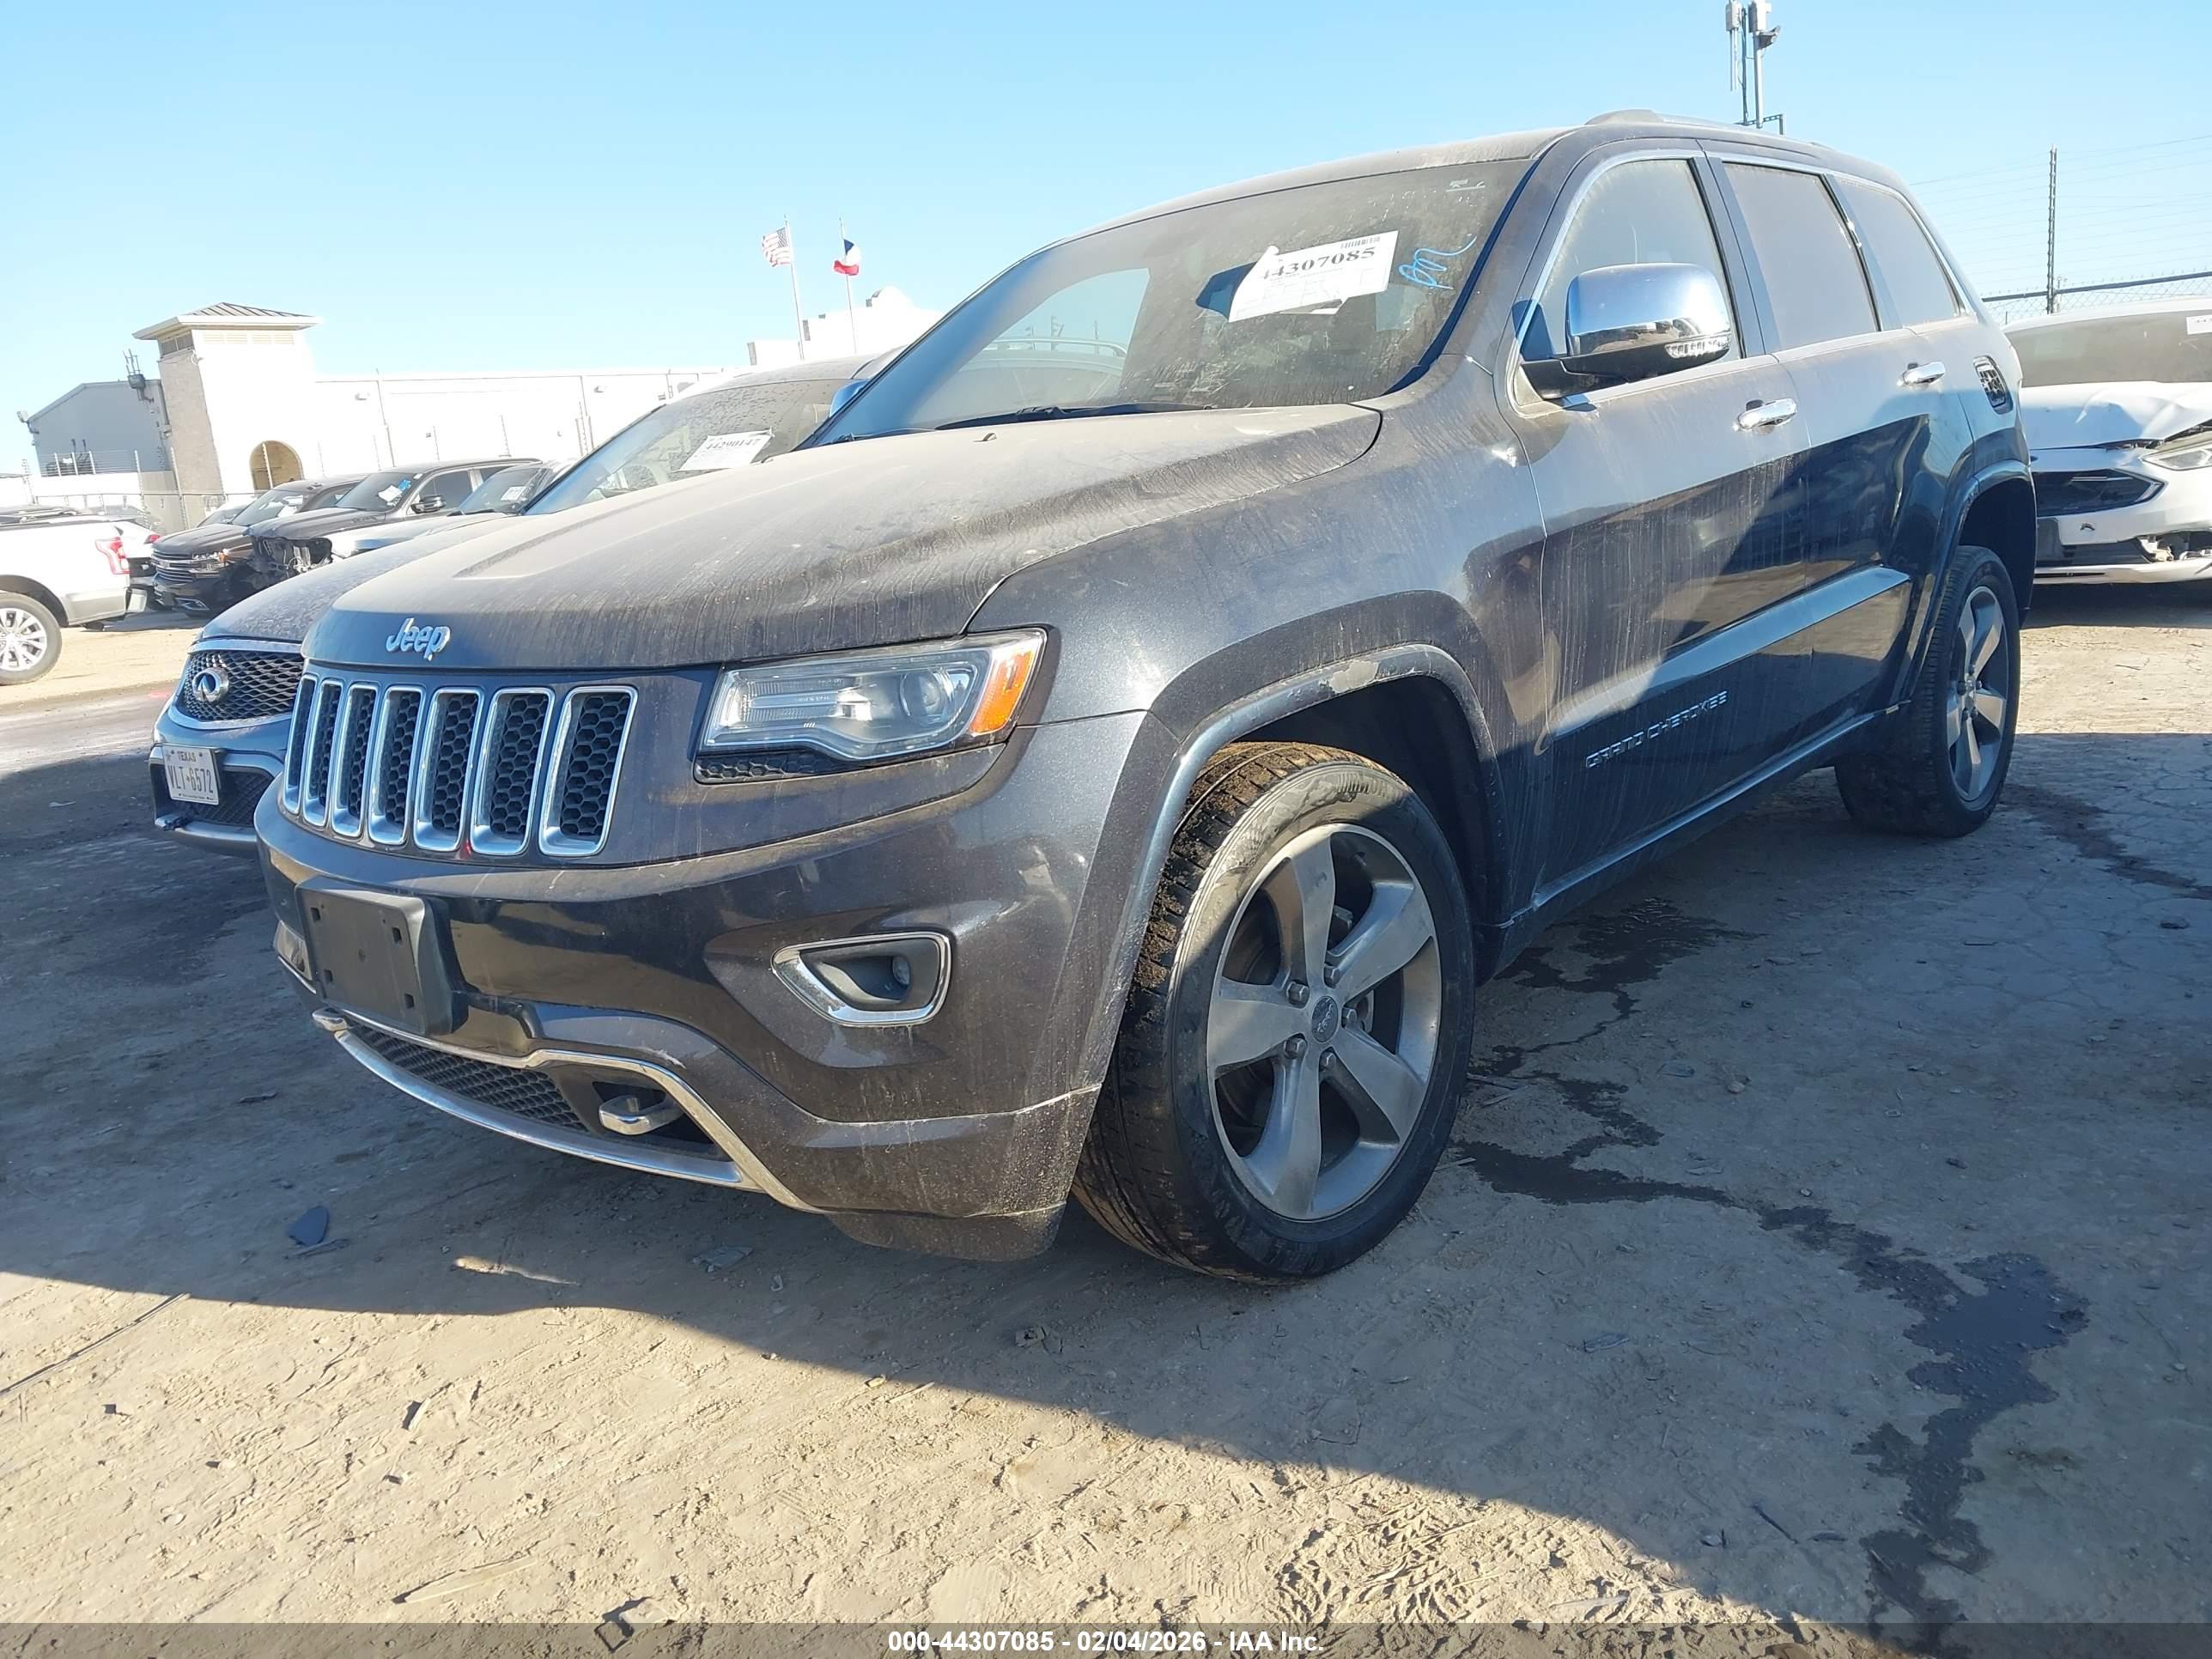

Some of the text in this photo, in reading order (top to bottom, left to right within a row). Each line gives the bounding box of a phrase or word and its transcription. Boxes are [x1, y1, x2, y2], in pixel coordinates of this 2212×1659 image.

[386, 617, 451, 661] Jeep
[1586, 690, 1728, 769] GRAND CHEROKEE
[177, 750, 196, 762] TEXAS
